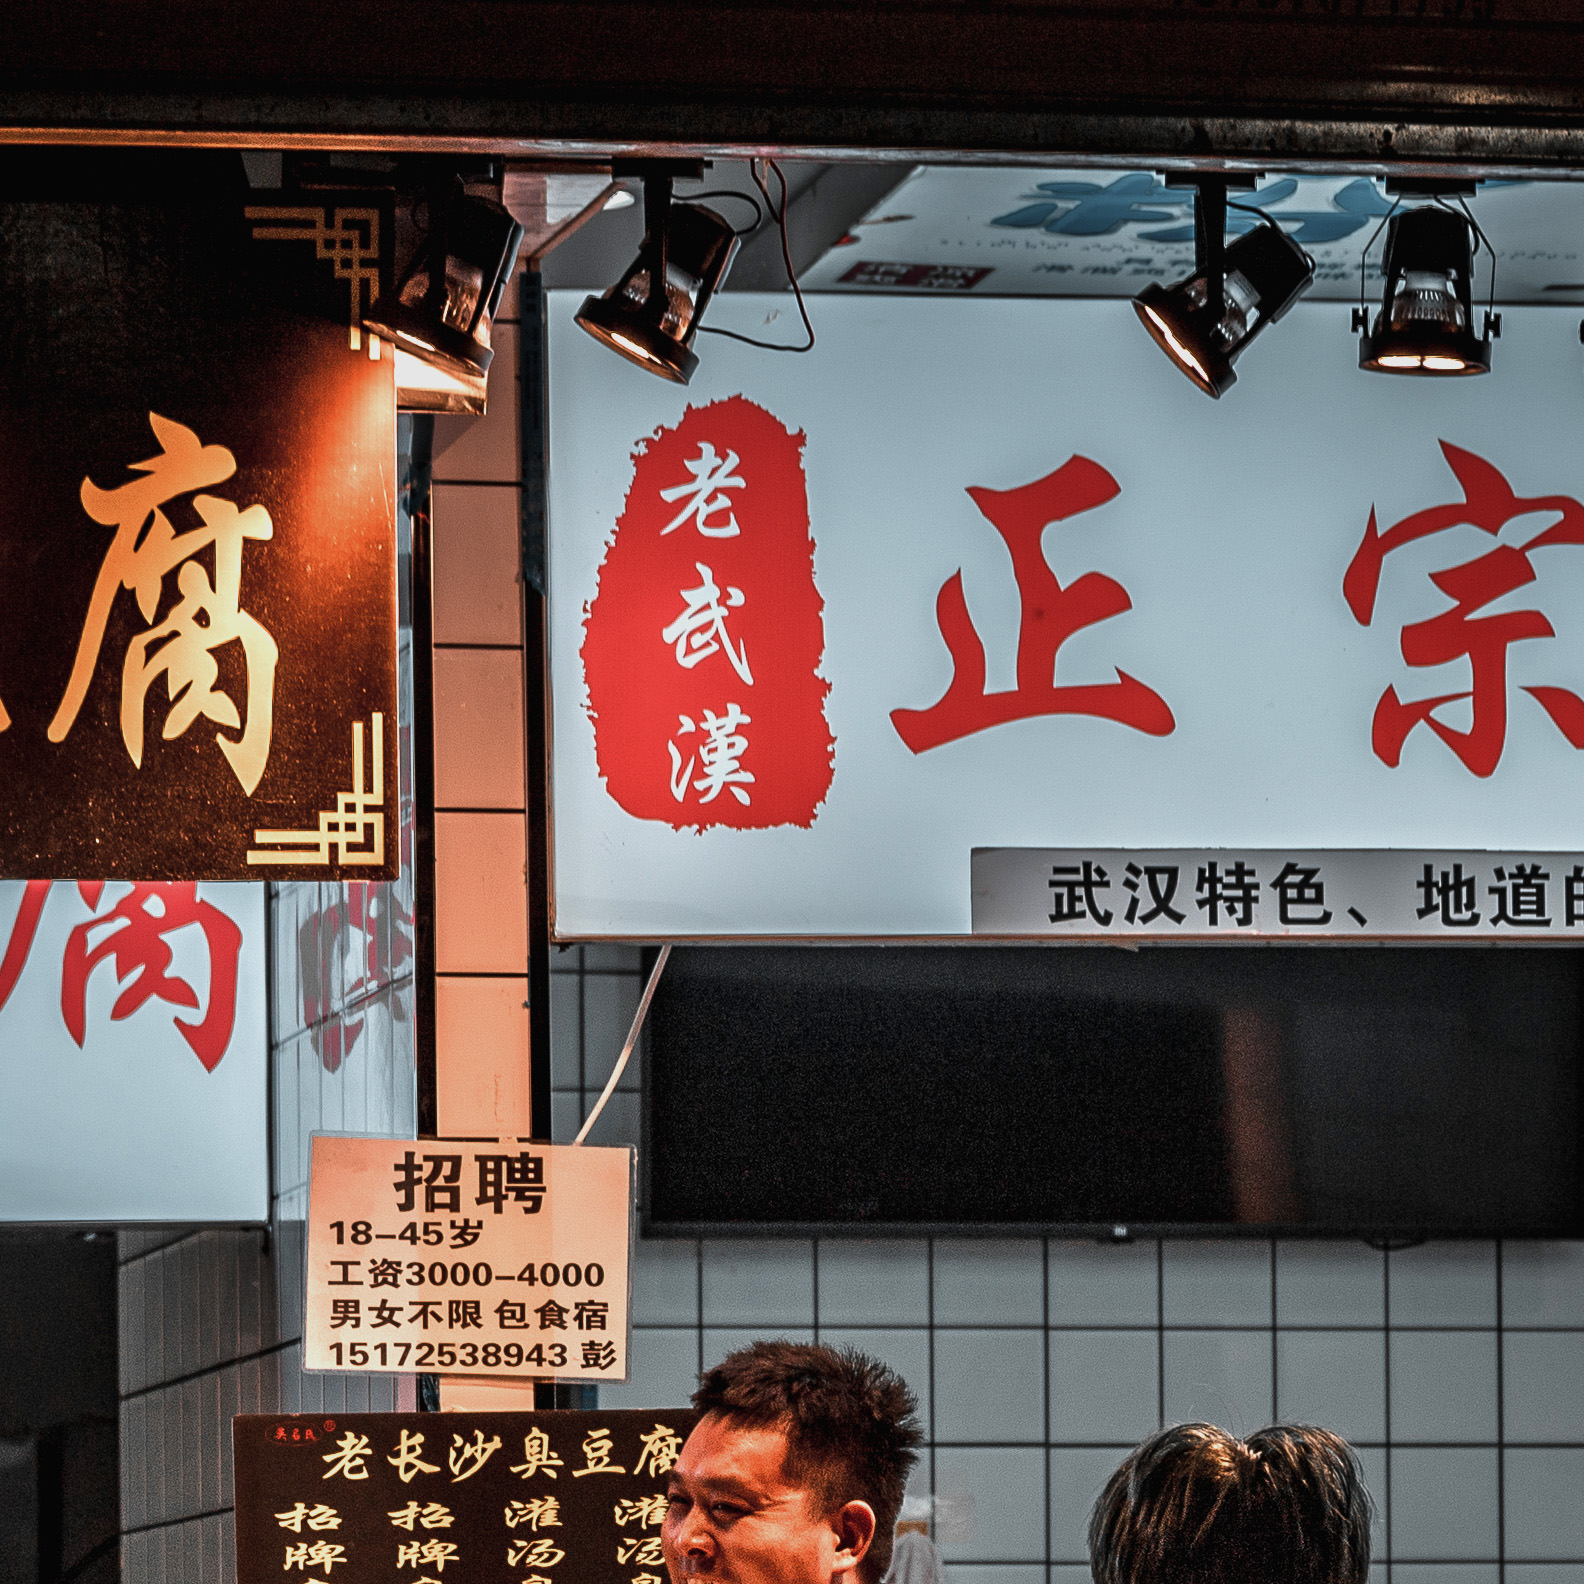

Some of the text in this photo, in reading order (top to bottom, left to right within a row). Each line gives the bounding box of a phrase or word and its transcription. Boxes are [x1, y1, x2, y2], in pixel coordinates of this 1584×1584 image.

[659, 441, 756, 806] 老武漢
[393, 1150, 548, 1215] 招聘
[328, 1218, 484, 1250] 18-45岁
[327, 1258, 605, 1289] 工资3000-4000
[329, 1299, 609, 1331] 男女不限 包食宿
[328, 1339, 618, 1371] 15172538943 彭
[322, 1424, 682, 1483] 老长沙臭豆腐
